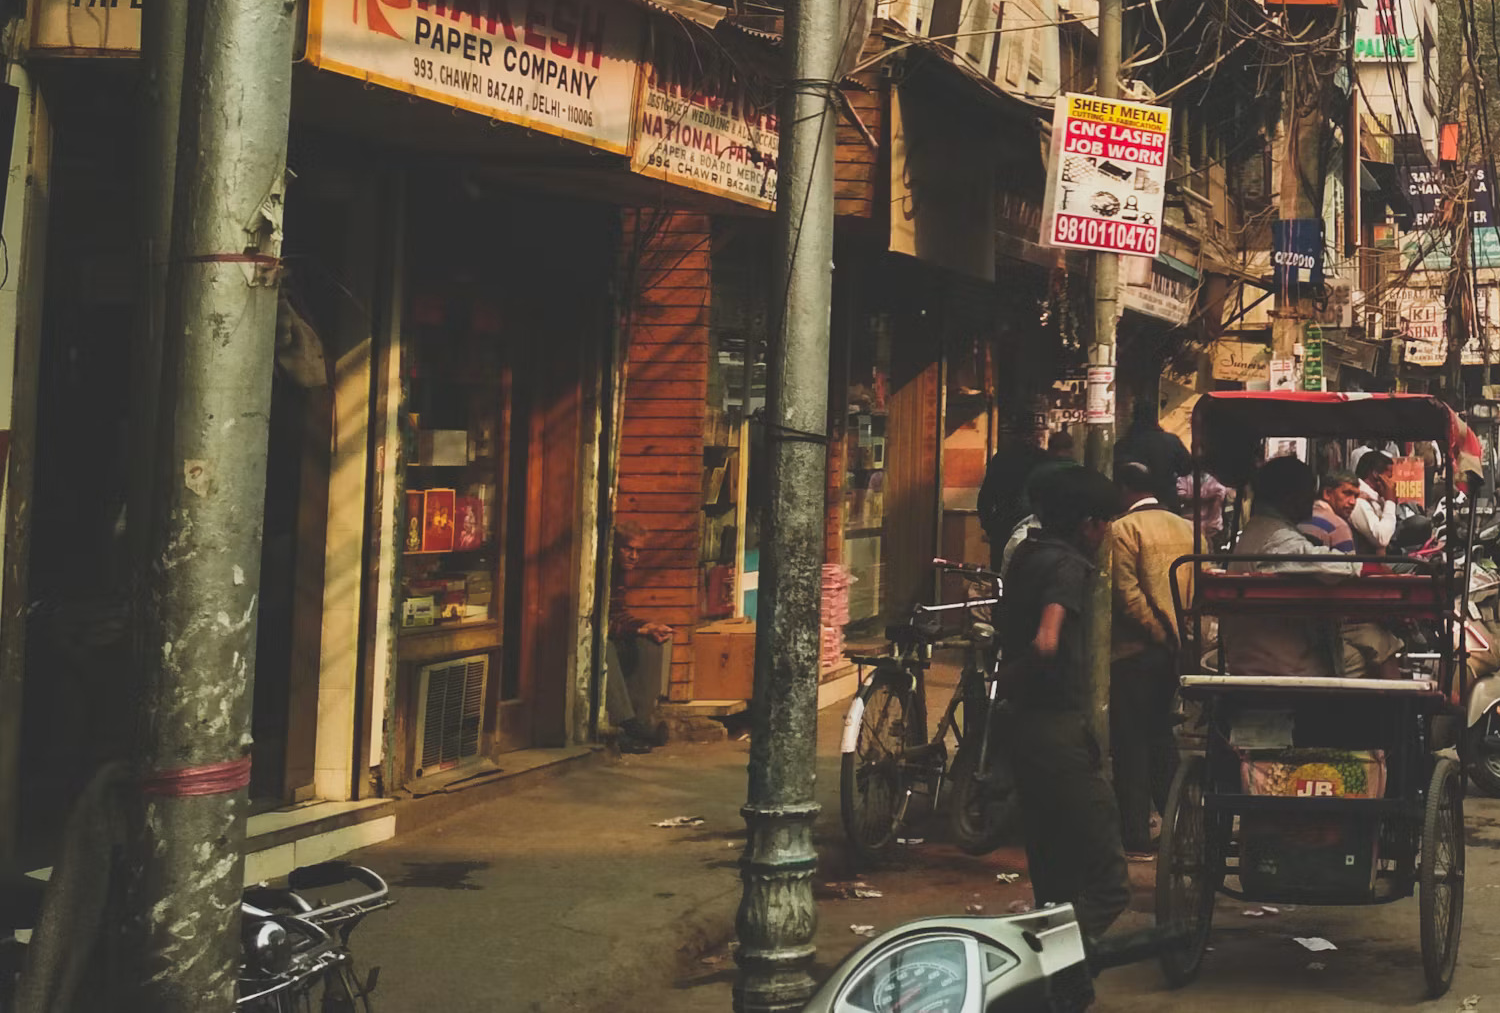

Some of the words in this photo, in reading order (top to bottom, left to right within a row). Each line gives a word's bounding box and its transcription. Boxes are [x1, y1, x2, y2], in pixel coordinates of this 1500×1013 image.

[414, 16, 493, 67] PAPER
[503, 45, 598, 100] COMPANY
[1355, 38, 1416, 58] PALACE
[440, 65, 482, 96] CHAWRI
[691, 108, 730, 132] WEDDING
[1072, 110, 1105, 123] CUTTING
[1116, 117, 1162, 132] FABRICATION
[1073, 98, 1116, 116] SHEET
[1120, 106, 1164, 124] METAL
[642, 111, 723, 157] NATIONAL
[1069, 120, 1108, 138] CNC
[1110, 124, 1165, 148] LASER
[656, 141, 687, 163] PAPER
[700, 156, 732, 175] BOARD
[1066, 137, 1104, 156] JOB
[1107, 144, 1163, 166] WORK
[677, 161, 723, 184] CHAWRI
[726, 176, 757, 194] BAZAR
[1057, 215, 1156, 253] 9810110476
[1296, 780, 1334, 797] JB
